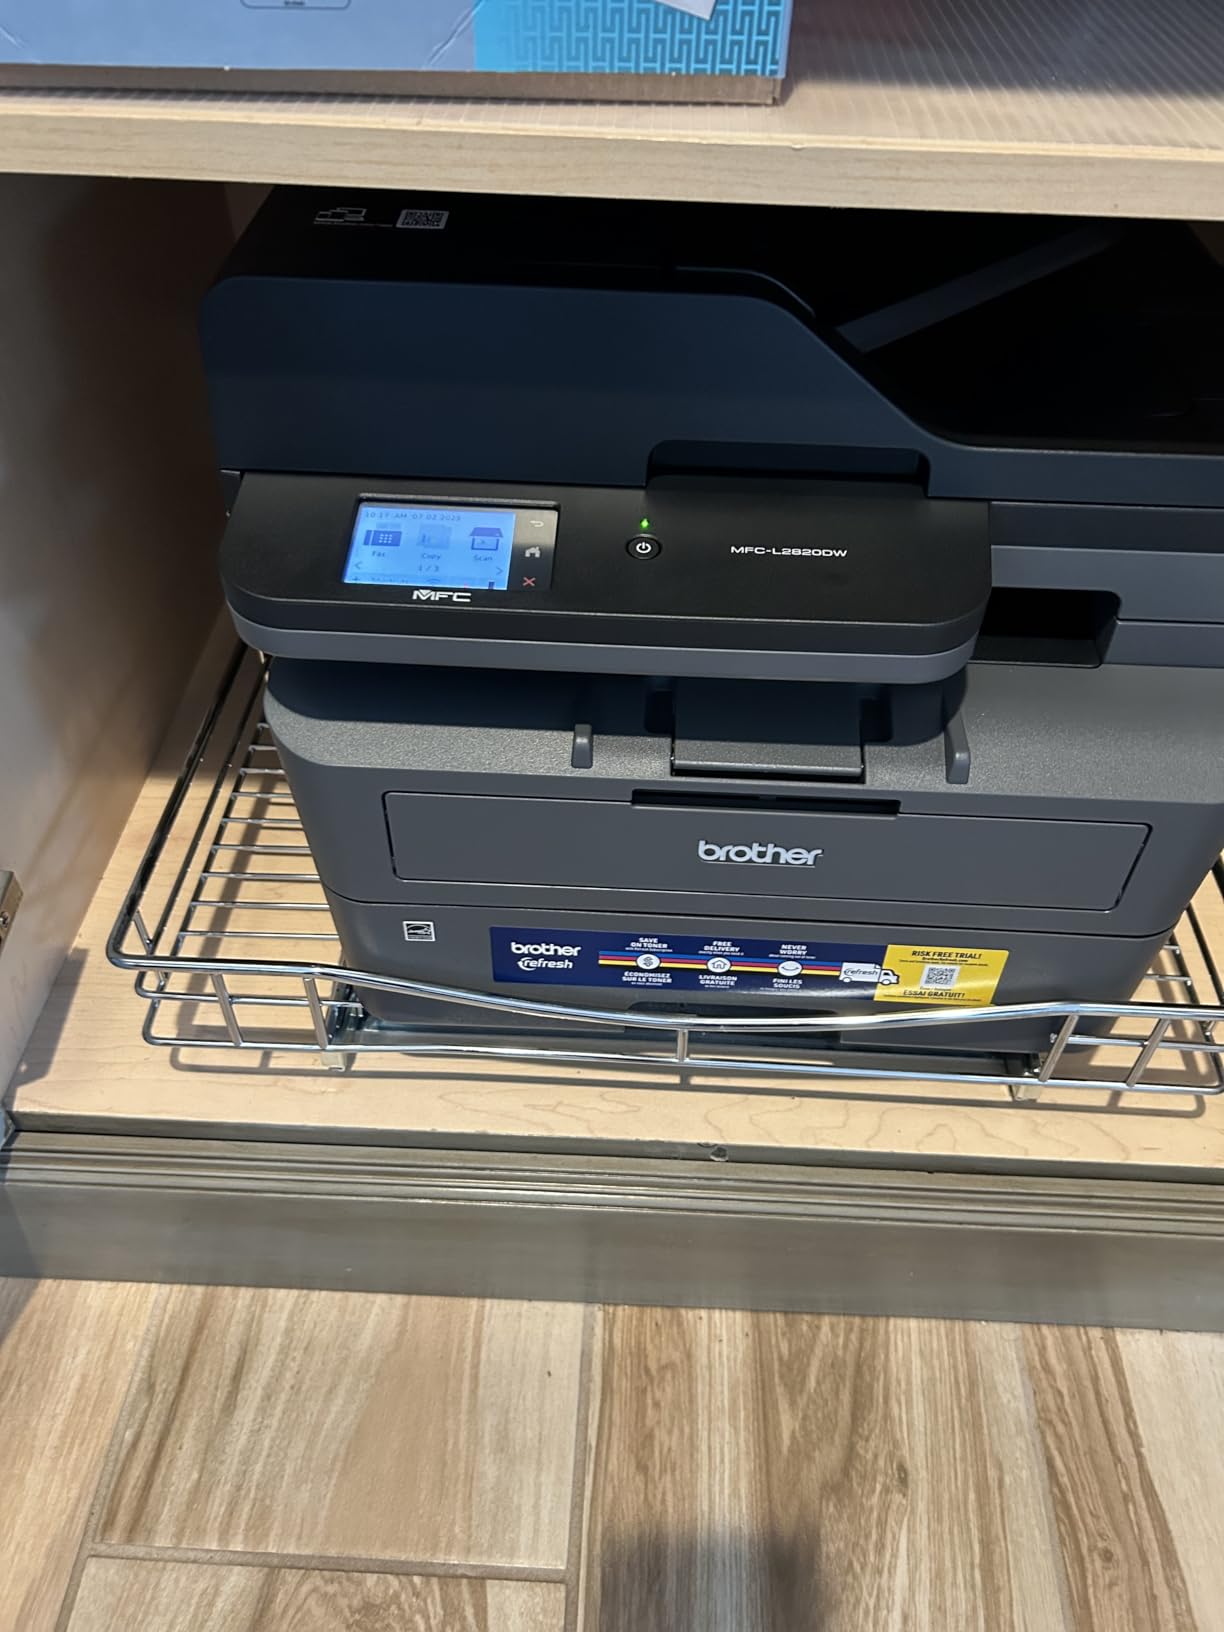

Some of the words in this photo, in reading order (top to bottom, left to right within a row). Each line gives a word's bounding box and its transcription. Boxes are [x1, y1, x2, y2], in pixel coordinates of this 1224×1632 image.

[421, 552, 441, 561] Copy
[730, 546, 848, 557] MFC-L2820DW
[473, 554, 493, 562] Scan
[412, 589, 472, 602] MFC
[698, 840, 823, 865] brother
[510, 942, 582, 956] brother
[954, 952, 982, 960] TRIAL!
[517, 957, 573, 971] refresh
[844, 968, 878, 976] refresh
[927, 990, 966, 998] GRATUIT!
